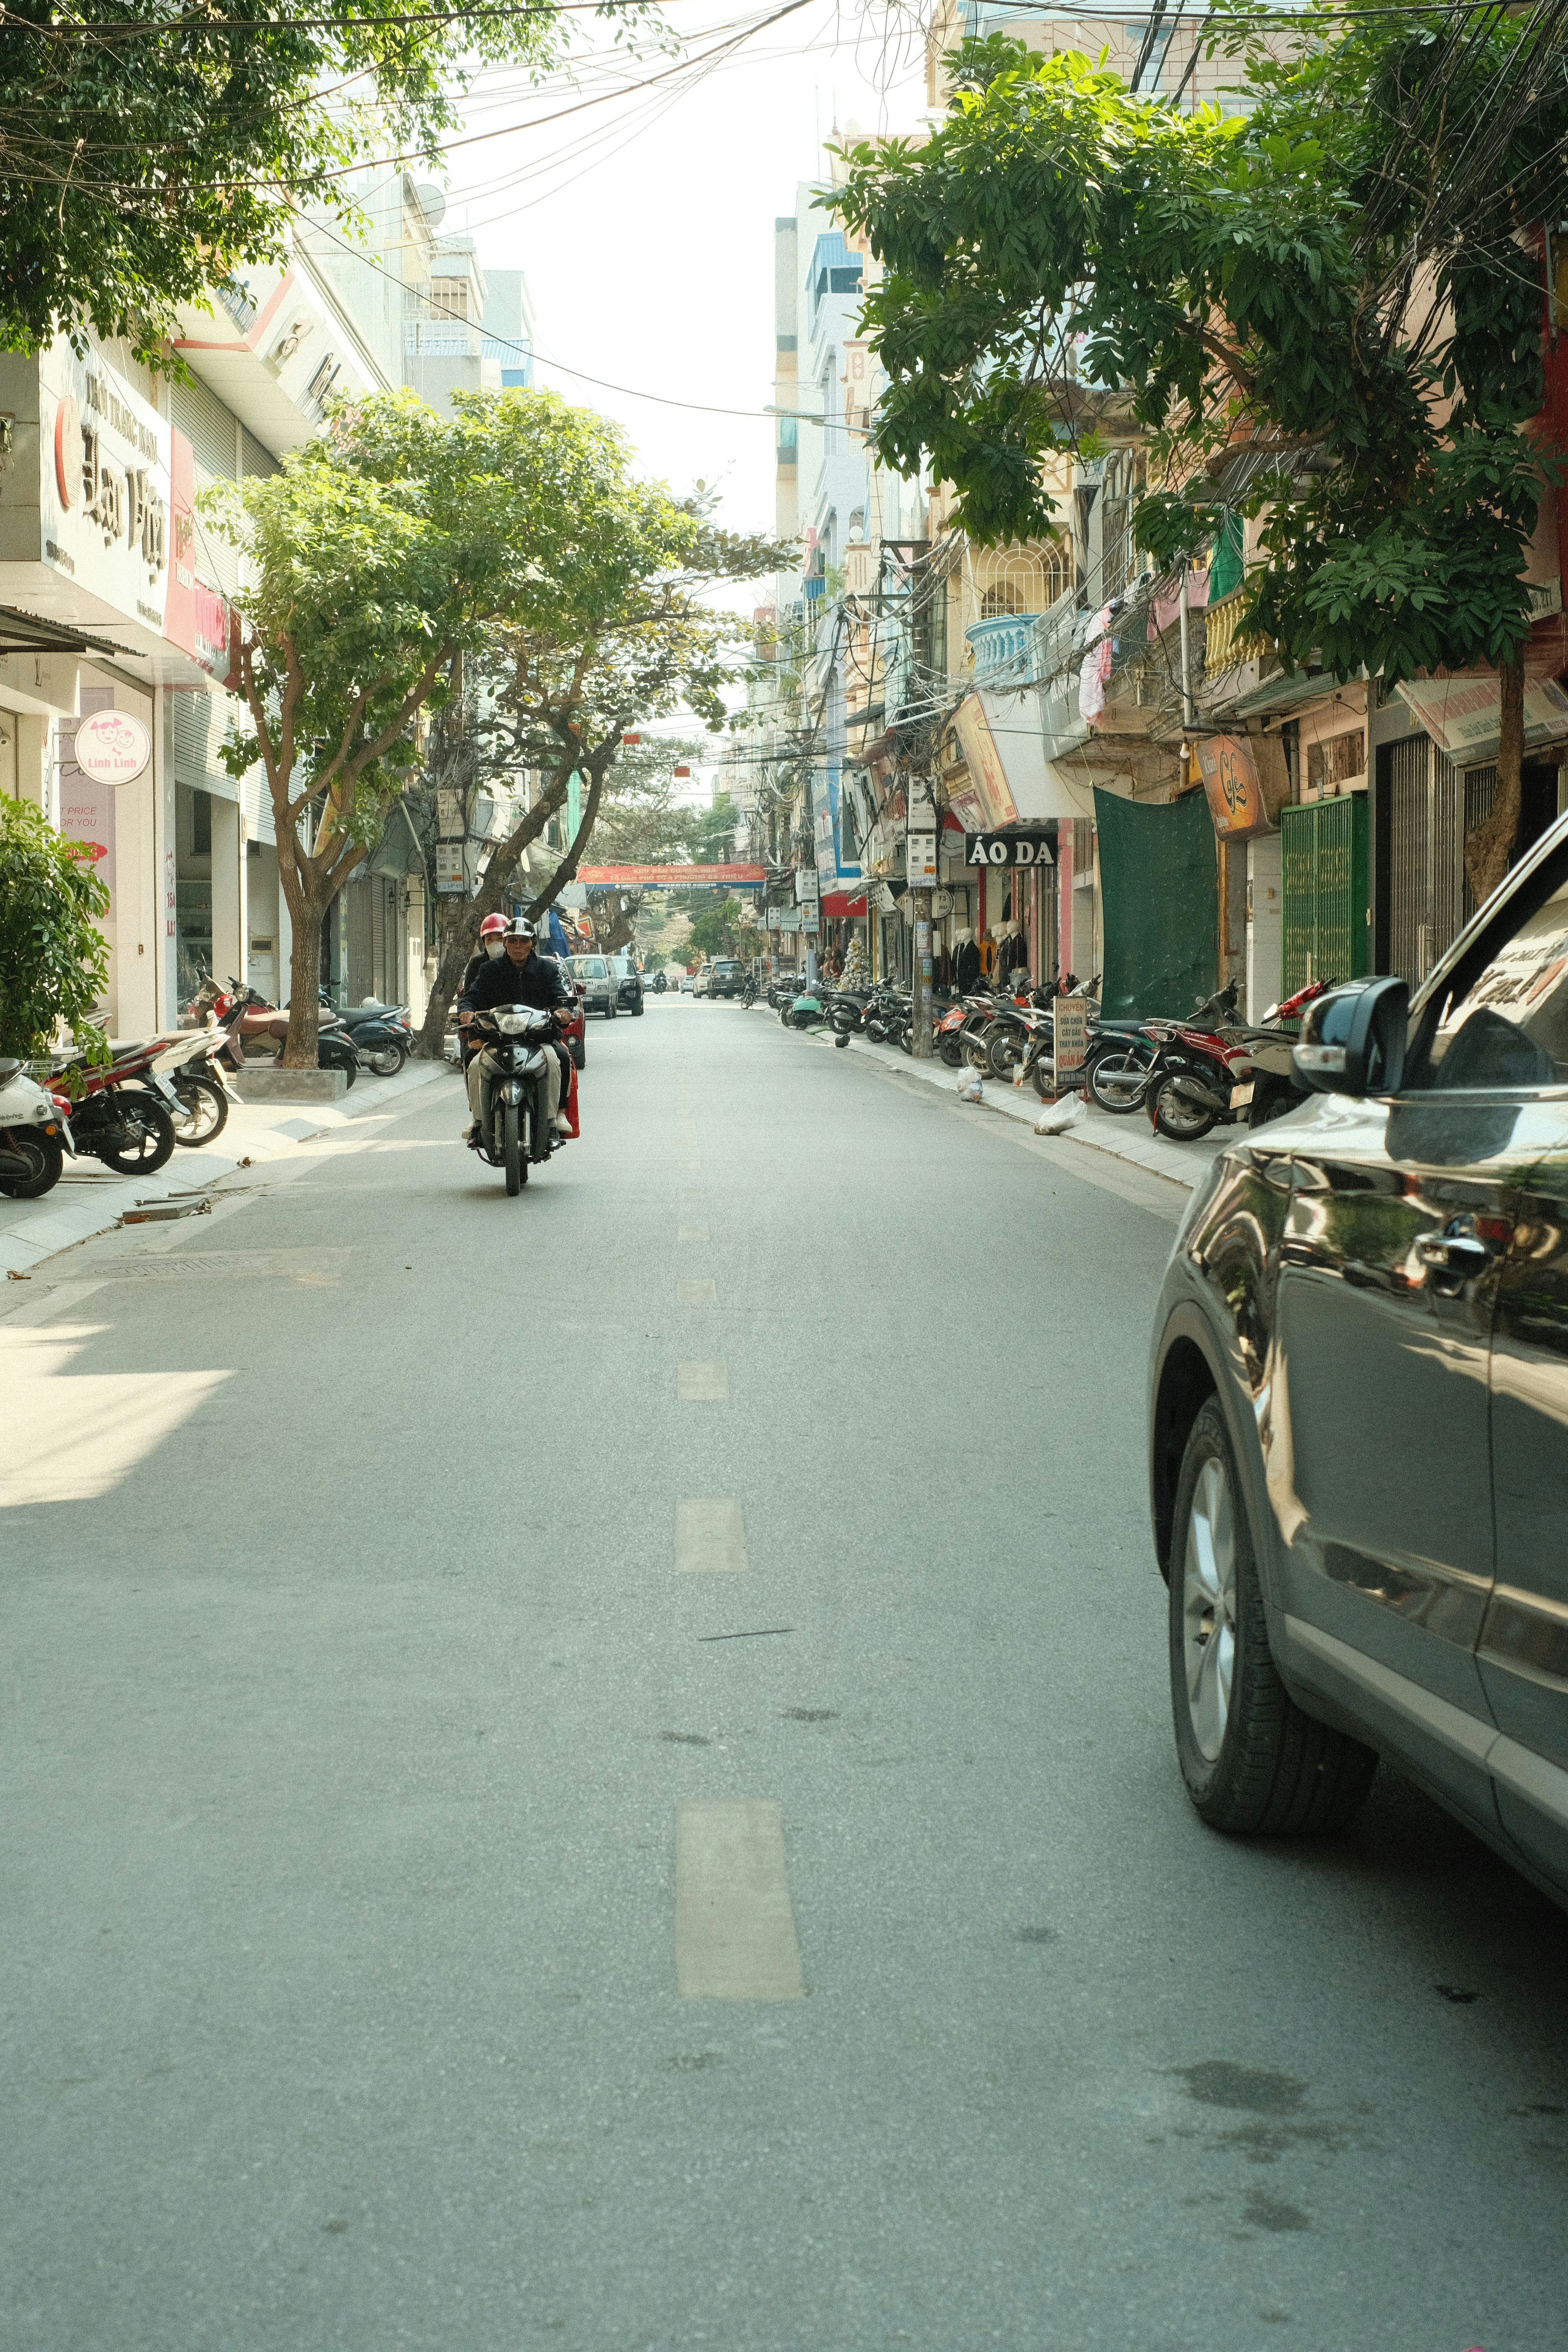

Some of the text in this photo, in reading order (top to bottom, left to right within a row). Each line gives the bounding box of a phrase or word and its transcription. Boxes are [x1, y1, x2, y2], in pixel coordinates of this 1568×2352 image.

[88, 758, 136, 768] Linh Linh
[77, 818, 97, 827] YOU
[969, 835, 1054, 864] ÁO DA
[1059, 1001, 1084, 1012] CHUYÊN
[1060, 1015, 1083, 1025] SỬA CHỮA
[1059, 1040, 1070, 1048] THAY
